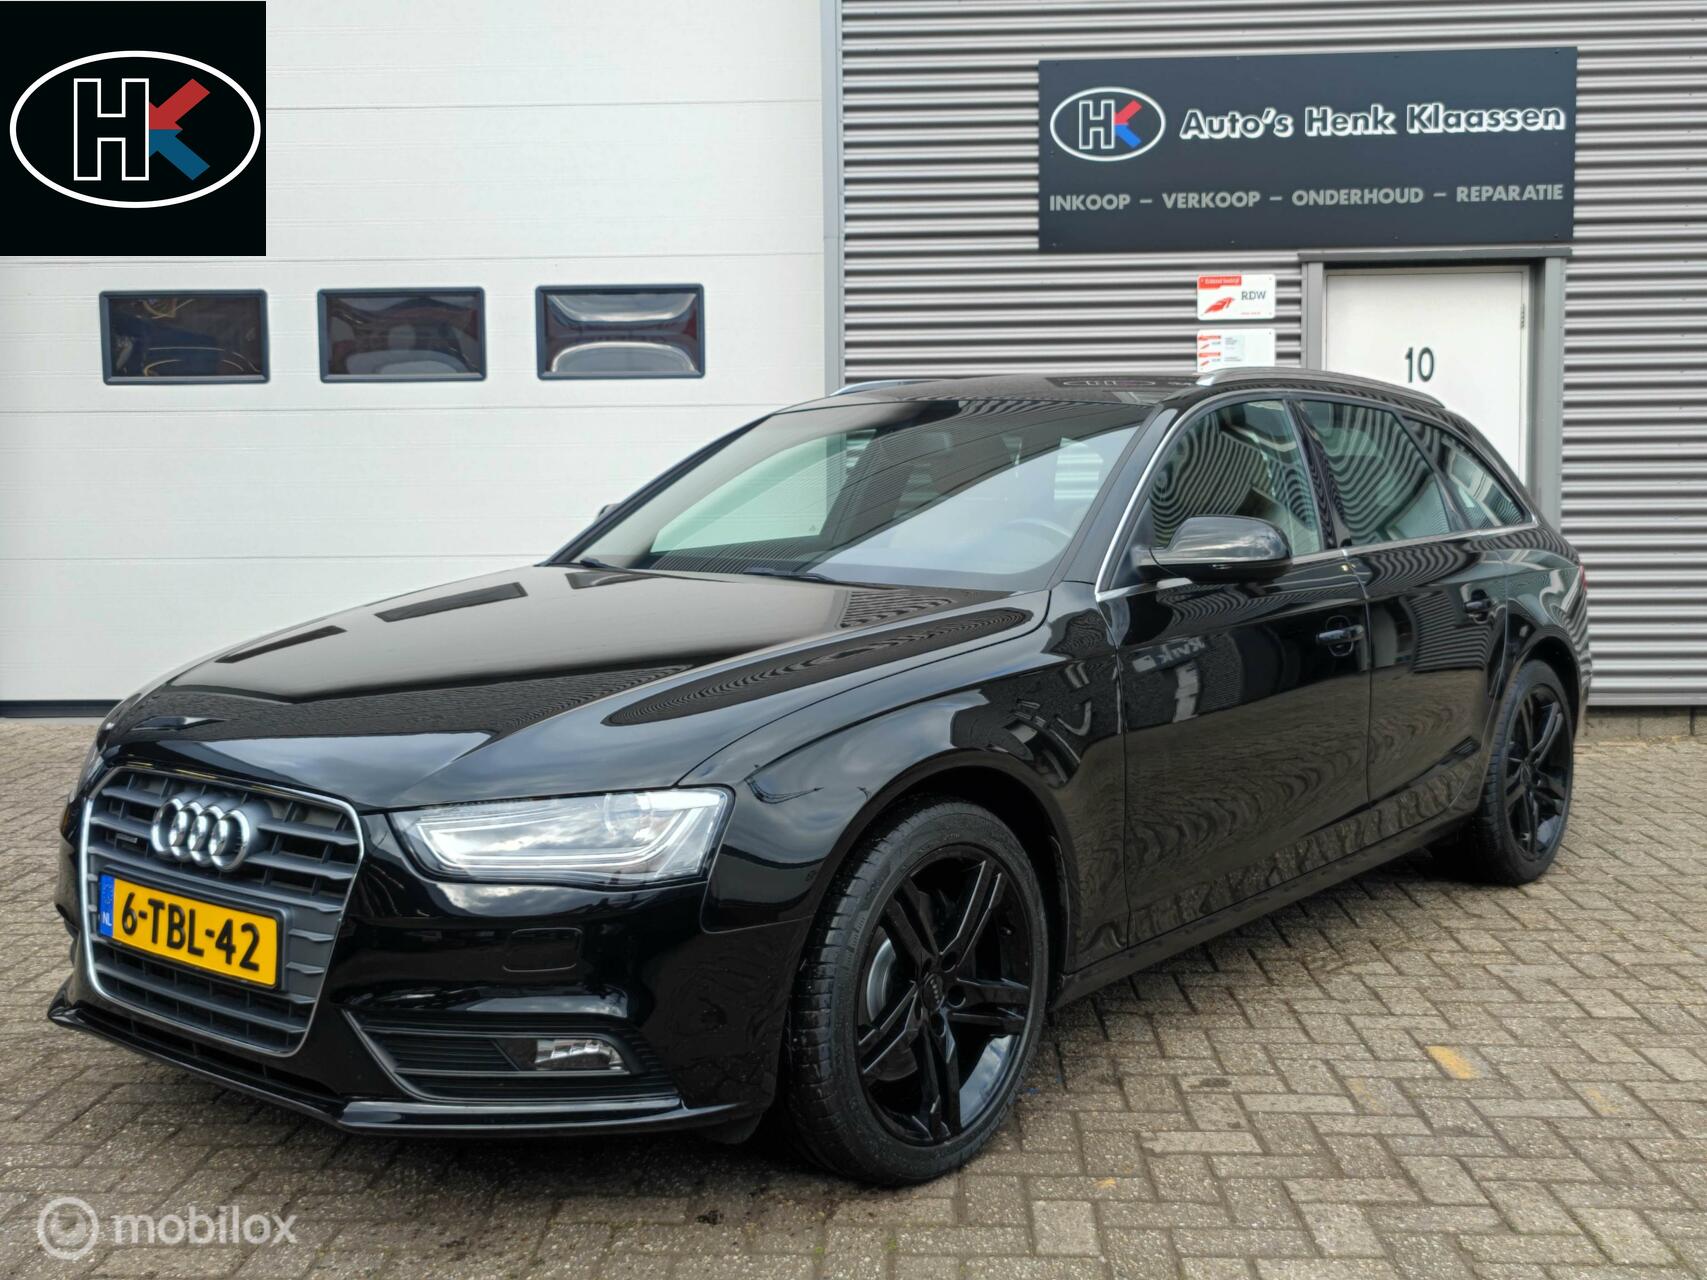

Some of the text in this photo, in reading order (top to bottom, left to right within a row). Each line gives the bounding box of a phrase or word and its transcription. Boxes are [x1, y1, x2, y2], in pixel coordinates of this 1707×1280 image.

[1179, 102, 1566, 139] Auto's Henk Klaassen
[1049, 194, 1131, 211] INKOOP
[1162, 191, 1261, 209] VERKOOP
[1291, 187, 1424, 206] ONDERHOUD
[1456, 184, 1564, 203] REPARATIE
[1241, 290, 1266, 301] RDW
[1405, 346, 1434, 383] 10
[102, 911, 112, 927] NL
[121, 892, 260, 972] 6-TBL-42
